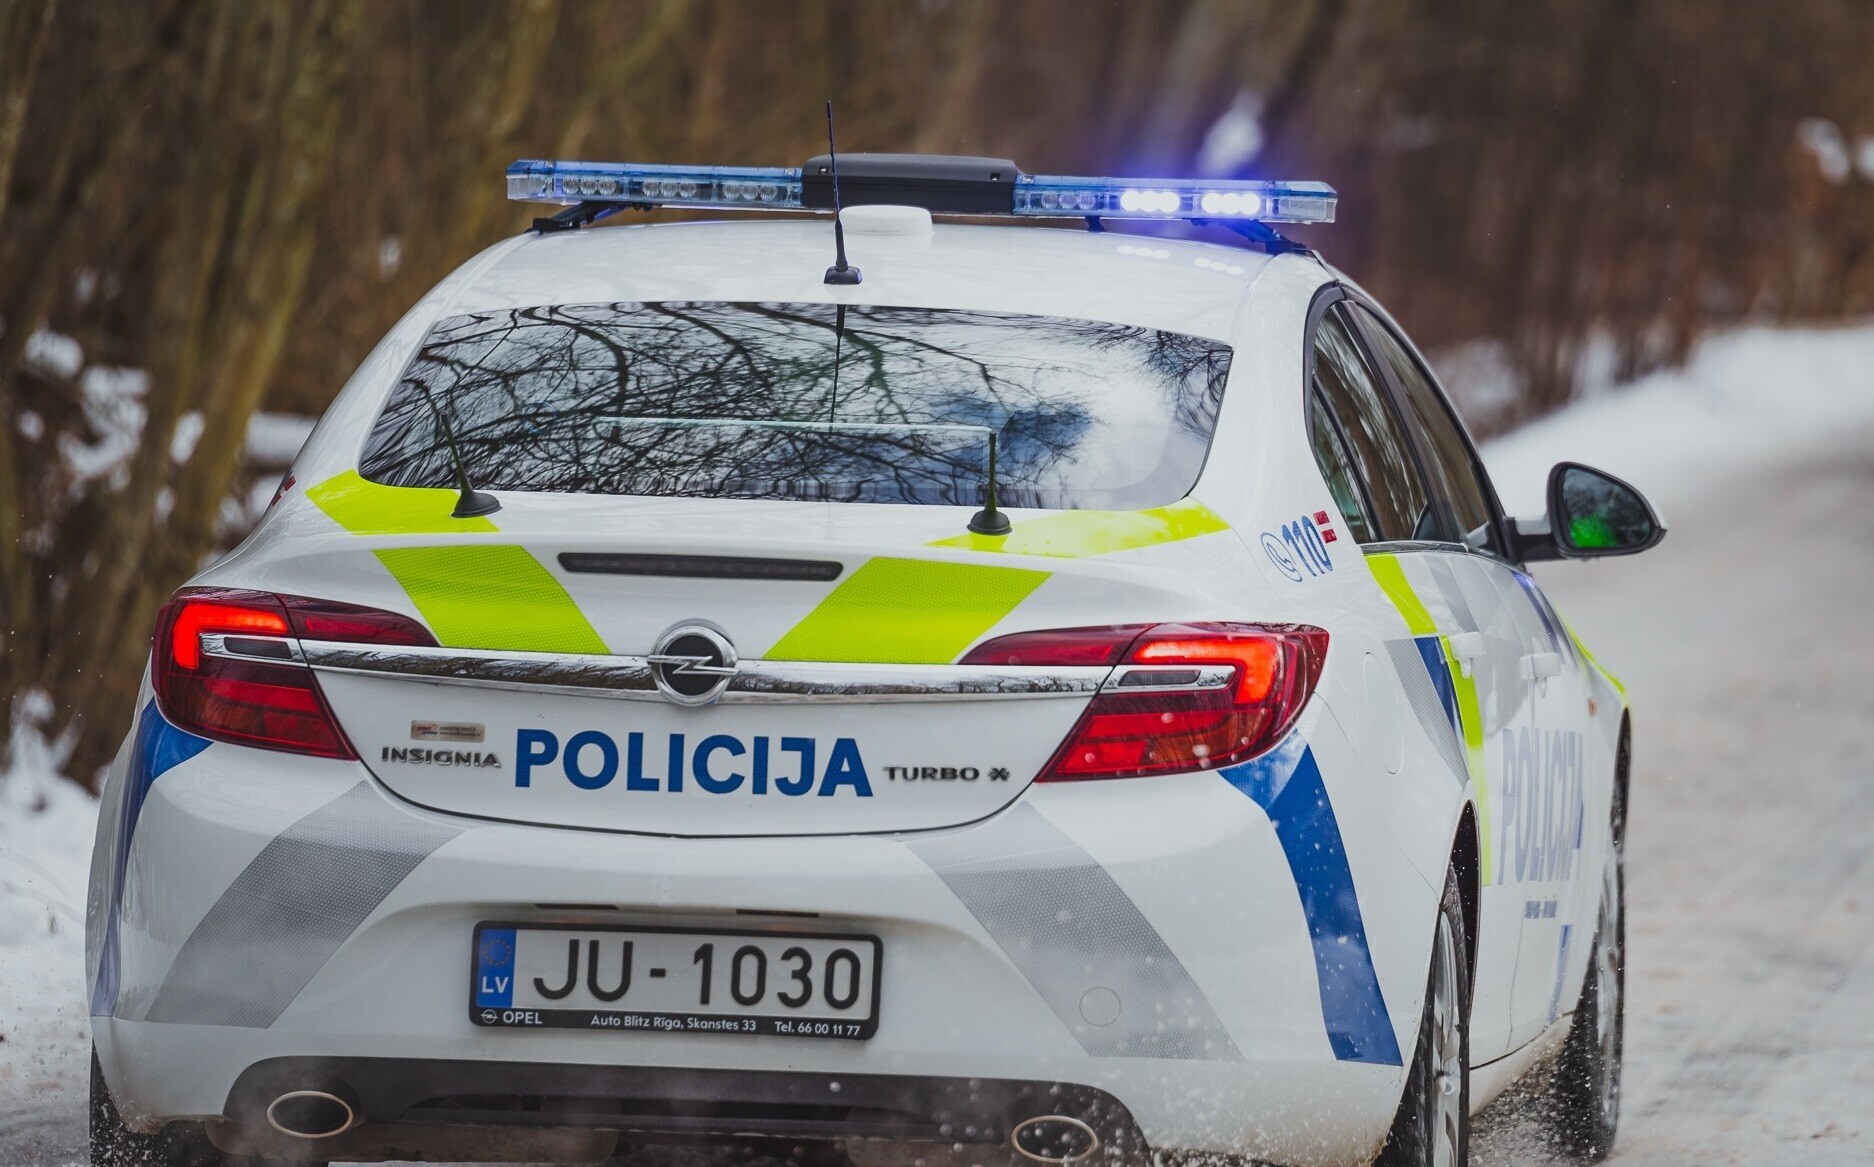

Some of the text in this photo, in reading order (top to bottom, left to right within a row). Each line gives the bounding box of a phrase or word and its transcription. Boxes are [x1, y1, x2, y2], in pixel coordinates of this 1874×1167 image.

[1282, 515, 1333, 577] 110
[381, 746, 502, 769] INSIGNIA
[515, 728, 874, 797] POLICIJA
[882, 765, 979, 782] TURBO
[481, 976, 509, 994] LV
[502, 1011, 543, 1025] OPEL
[590, 1014, 621, 1027] Auto
[624, 1016, 650, 1028] Blitz
[687, 1017, 739, 1031] Skanstes
[742, 1019, 757, 1031] 33
[774, 1021, 861, 1037] Tel. 66 00 11 77
